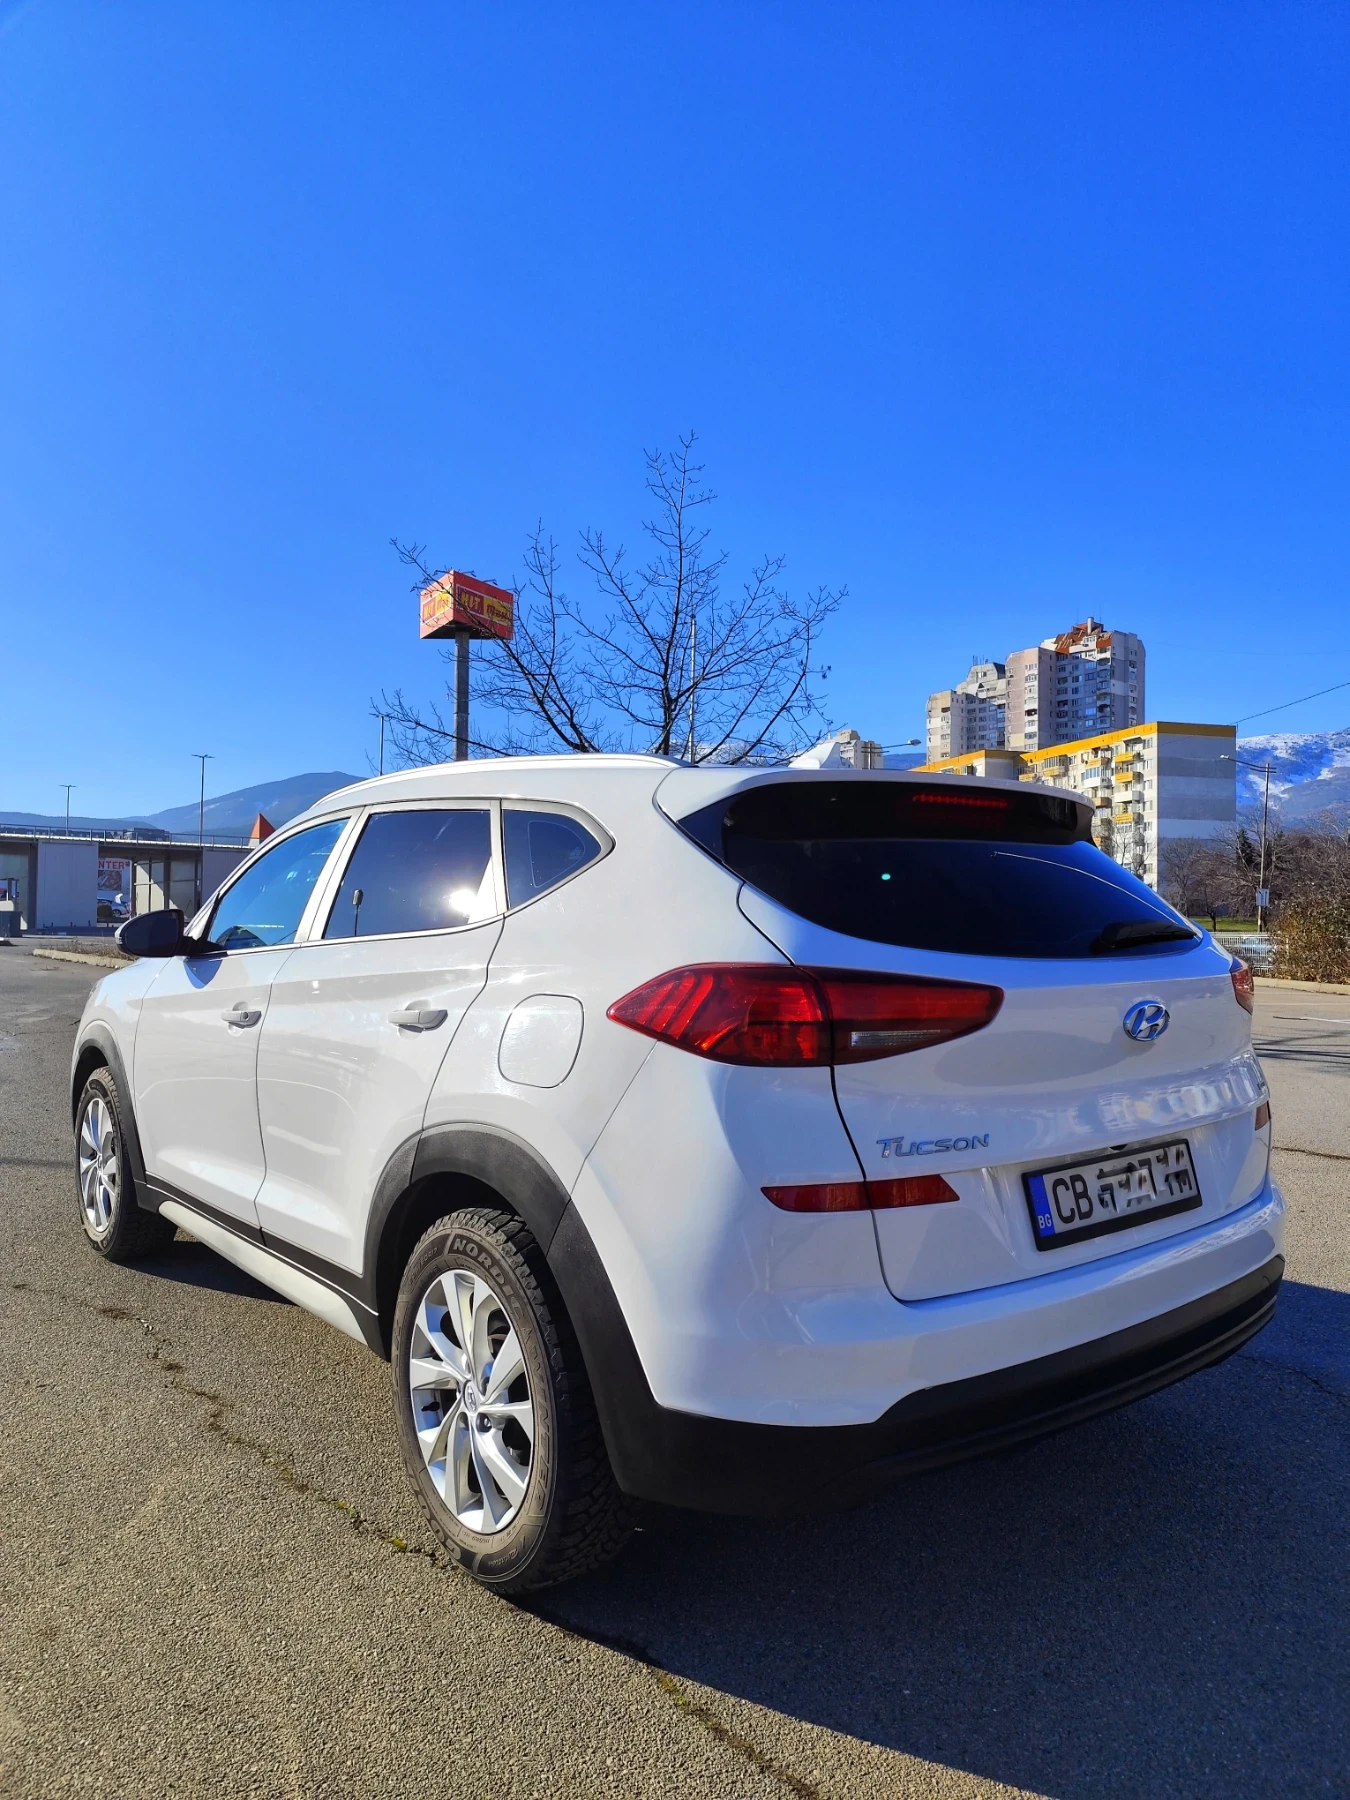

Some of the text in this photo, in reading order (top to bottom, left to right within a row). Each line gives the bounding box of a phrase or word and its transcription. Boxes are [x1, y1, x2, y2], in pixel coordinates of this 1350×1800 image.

[876, 1133, 990, 1158] TUCSON
[1037, 1213, 1053, 1229] BG
[453, 1238, 525, 1319] NORDIC
